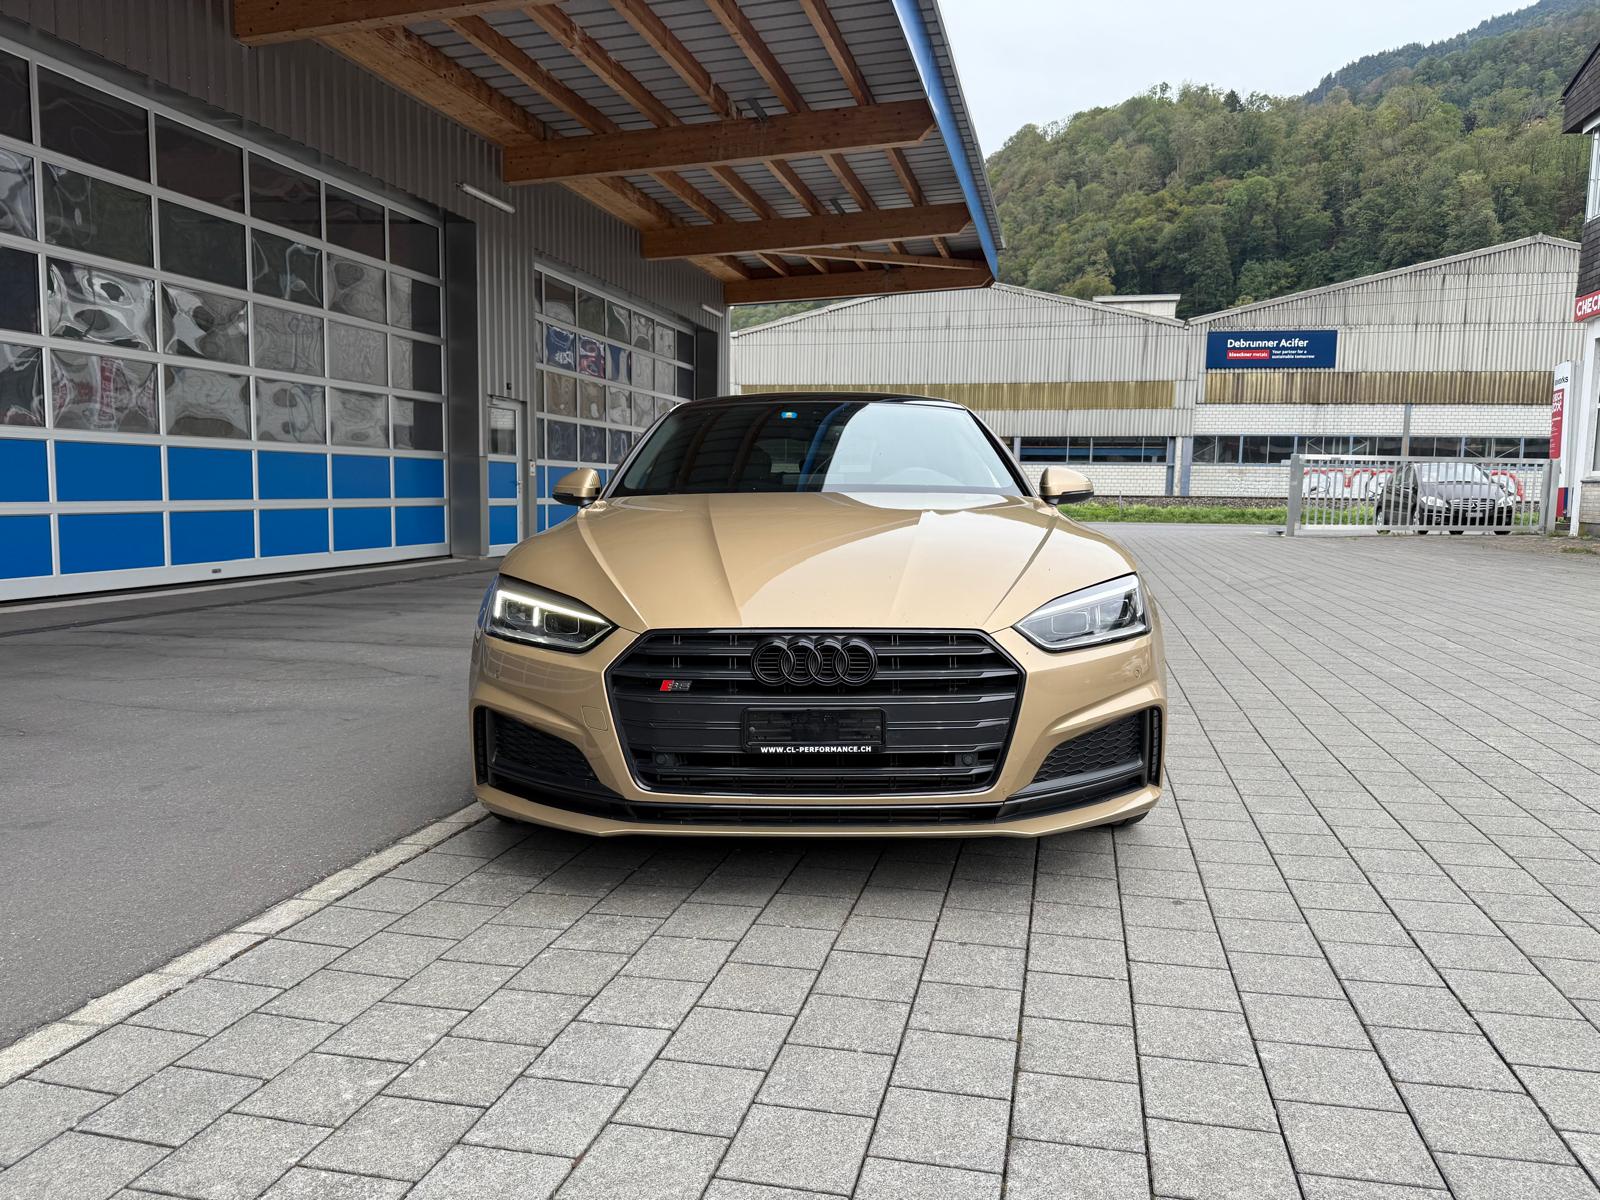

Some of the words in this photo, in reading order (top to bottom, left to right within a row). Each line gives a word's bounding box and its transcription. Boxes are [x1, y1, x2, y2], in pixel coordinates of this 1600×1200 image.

[1227, 338, 1278, 348] Debrunner
[1280, 337, 1309, 348] Acifer
[760, 745, 872, 753] WWW.CL-PERFORMANCE.CH
